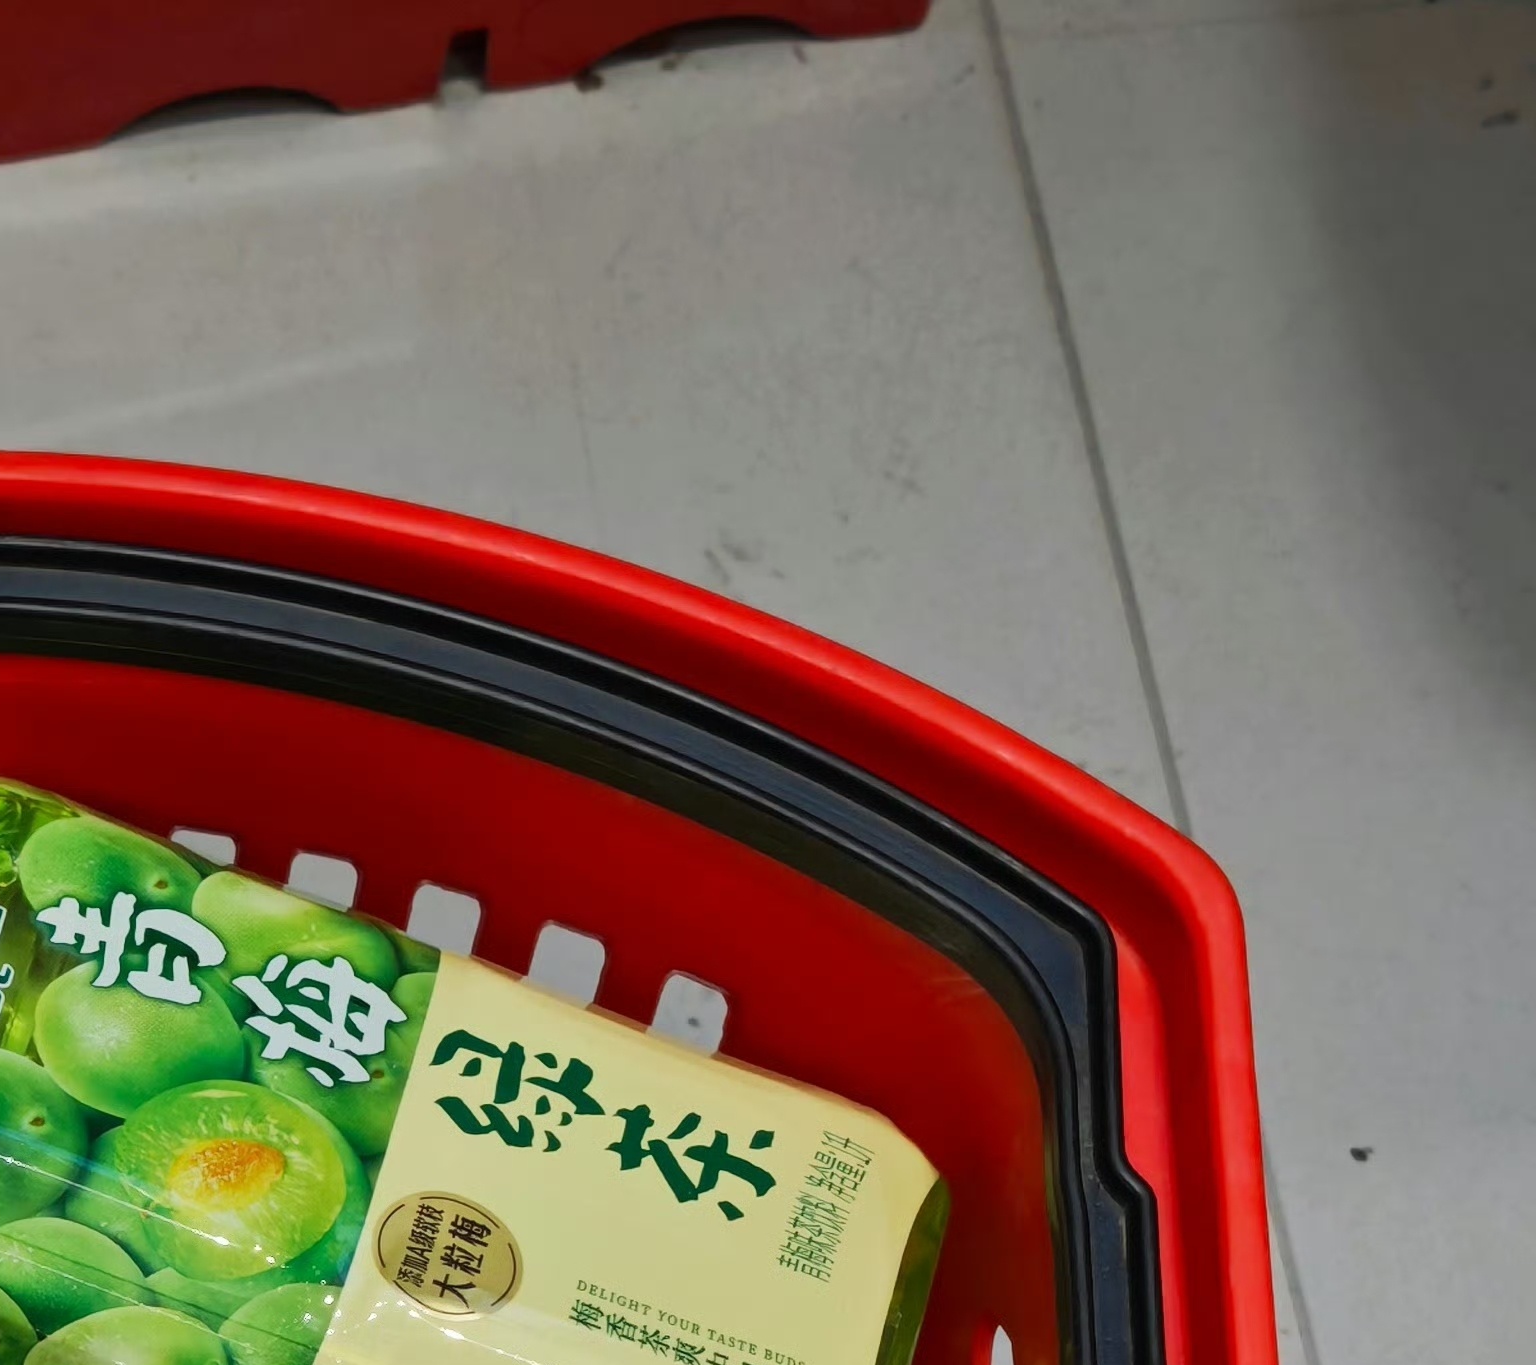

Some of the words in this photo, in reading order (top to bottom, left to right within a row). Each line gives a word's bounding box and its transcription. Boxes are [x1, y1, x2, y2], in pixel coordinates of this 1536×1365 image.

[430, 1029, 776, 1222] 绿茶
[397, 1203, 445, 1290] 添加A级软枝
[432, 1213, 494, 1309] 大粒梅
[575, 1279, 651, 1318] DELIGHT
[657, 1308, 703, 1336] YOUR
[707, 1327, 759, 1356] TASTE
